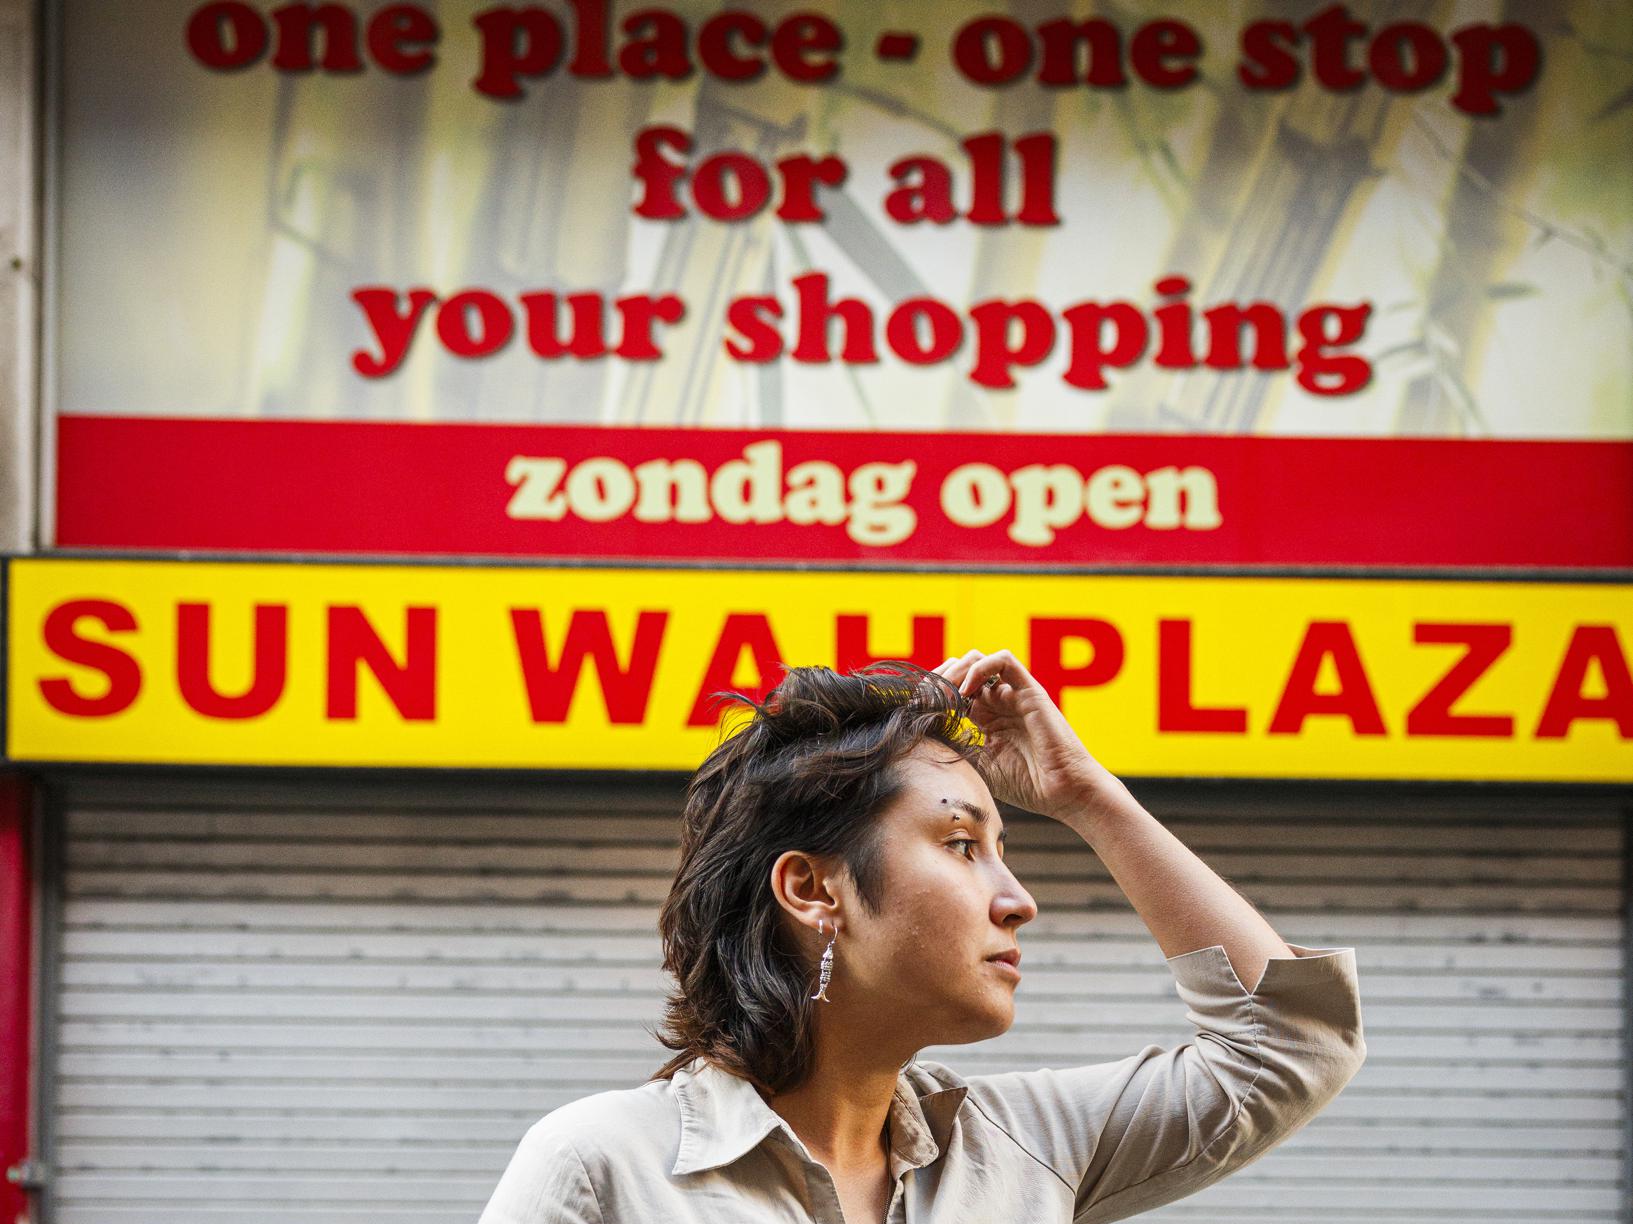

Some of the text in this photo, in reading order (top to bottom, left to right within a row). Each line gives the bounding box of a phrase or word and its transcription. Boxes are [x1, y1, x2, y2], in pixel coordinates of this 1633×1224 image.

[186, 0, 438, 74] one
[474, 0, 842, 100] place
[953, 16, 1201, 88] one
[1238, 5, 1540, 115] stop
[634, 126, 1059, 226] for all
[352, 273, 1372, 396] your shopping
[506, 441, 1222, 546] zondag open
[36, 598, 440, 721] SUN
[1028, 616, 1633, 740] PLAZA
